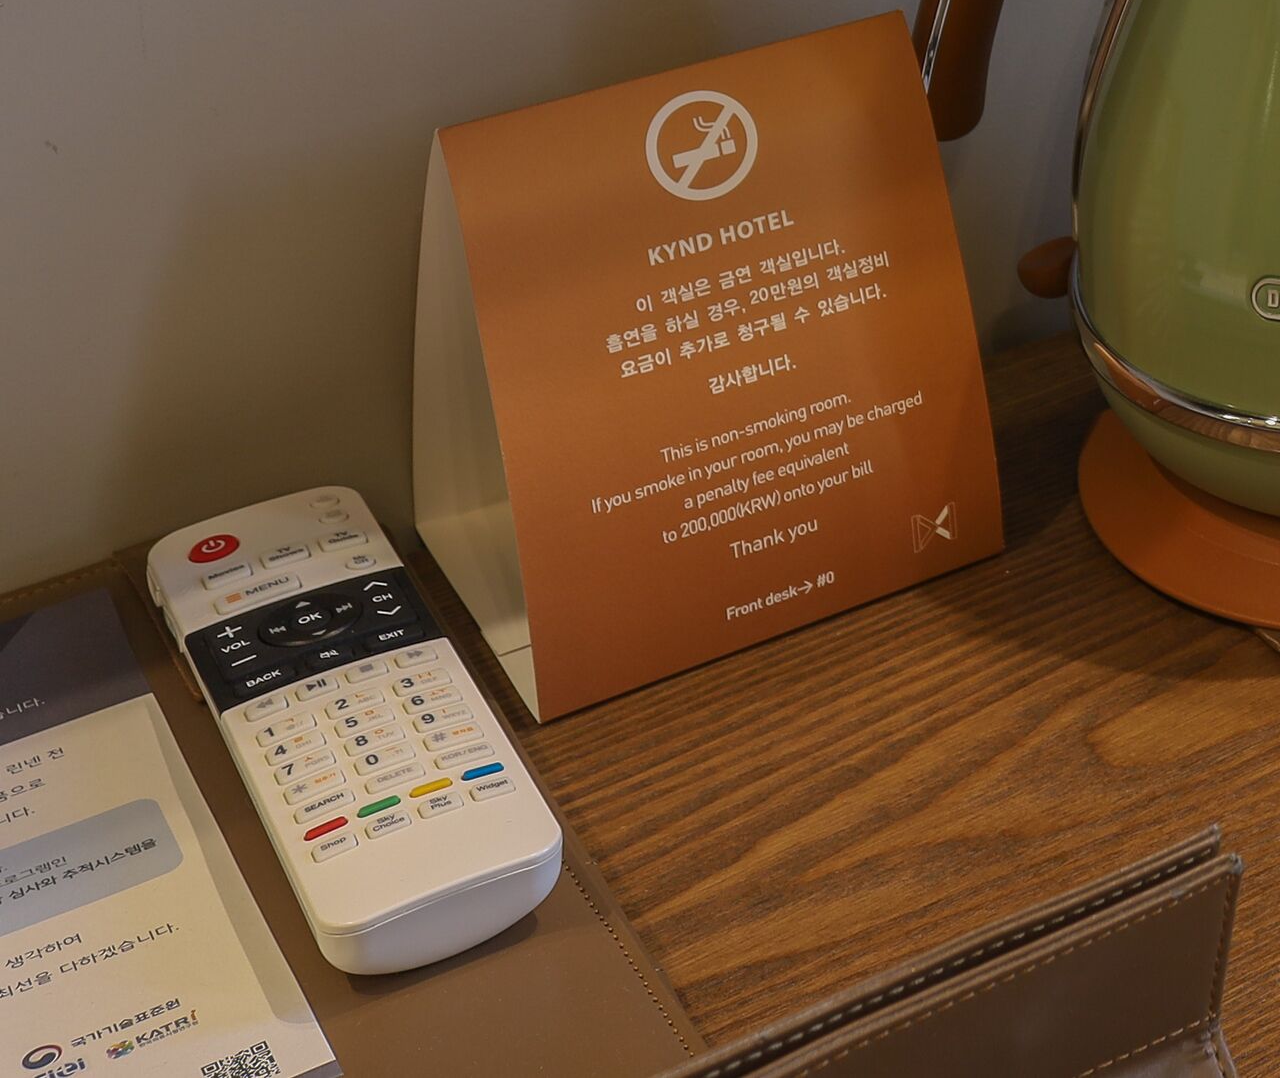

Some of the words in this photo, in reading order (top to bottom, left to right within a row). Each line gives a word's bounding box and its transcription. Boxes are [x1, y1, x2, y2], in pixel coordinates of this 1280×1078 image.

[647, 234, 713, 266] KYND
[719, 209, 794, 245] HOTEL
[635, 295, 653, 313] 이
[660, 277, 711, 305] 객실은
[718, 265, 752, 287] 금연
[759, 238, 846, 274] 객실입니다.
[605, 323, 657, 354] 흡연을
[664, 310, 699, 334] 하실
[707, 298, 747, 322] 경우,
[749, 272, 819, 305] 20만원의
[825, 250, 890, 282] 객실정비
[620, 349, 671, 378] 요금이
[679, 332, 730, 359] 추가로
[737, 312, 787, 342] 청구될
[794, 305, 810, 323] 수
[817, 283, 887, 317] 있습니다.
[707, 353, 797, 395] 감사합니다.
[660, 442, 693, 464] This
[695, 438, 709, 452] is
[711, 406, 807, 449] non-smoking
[810, 393, 851, 415] room.
[591, 499, 602, 514] If
[603, 491, 633, 513] you
[634, 472, 686, 500] smoke
[688, 466, 703, 482] in
[704, 456, 737, 483] your
[740, 441, 784, 466] room,
[784, 432, 812, 453] you
[813, 420, 845, 443] may
[845, 411, 865, 428] be
[866, 390, 924, 423] charged
[683, 496, 693, 510] a
[696, 475, 750, 510] penalty
[752, 468, 775, 486] fee
[778, 441, 851, 479] equivalent
[662, 529, 678, 544] to
[680, 489, 781, 540] 200,000(KRW)
[783, 480, 815, 503] onto
[816, 471, 849, 495] your
[851, 459, 874, 479] bill
[729, 528, 785, 559] Thank
[787, 519, 819, 543] you
[245, 576, 289, 596] MENU
[372, 592, 393, 604] CH
[725, 597, 763, 621] Front
[816, 570, 835, 588] #0
[298, 611, 323, 625] OK
[378, 628, 406, 641] EXIT
[220, 638, 250, 654] VOL
[246, 669, 282, 688] BACK
[400, 677, 414, 690] 3
[335, 698, 349, 710] 2
[411, 695, 425, 706] 6
[345, 716, 358, 729] 5
[421, 713, 435, 725] 9
[264, 727, 275, 738] 1
[354, 734, 369, 747] 8
[273, 744, 288, 757] 4
[6, 755, 42, 774] 린넨
[48, 747, 64, 760] 전
[365, 754, 379, 766] 0
[282, 764, 296, 776] 7
[376, 766, 414, 783] DELETE
[475, 778, 508, 793] Widget
[304, 793, 345, 813] SEARCH
[429, 795, 448, 806] Sky
[430, 801, 452, 810] Plus
[372, 816, 405, 832] Choice
[377, 814, 396, 824] Sky
[320, 836, 347, 852] Shop
[0, 856, 67, 888] 로그램인
[9, 875, 58, 900] 심사와
[62, 838, 157, 879] 추적시스템을
[5, 933, 82, 969] 생각하여
[59, 923, 180, 973] 다하겠습니다.
[71, 998, 181, 1048] 국가기술표준원
